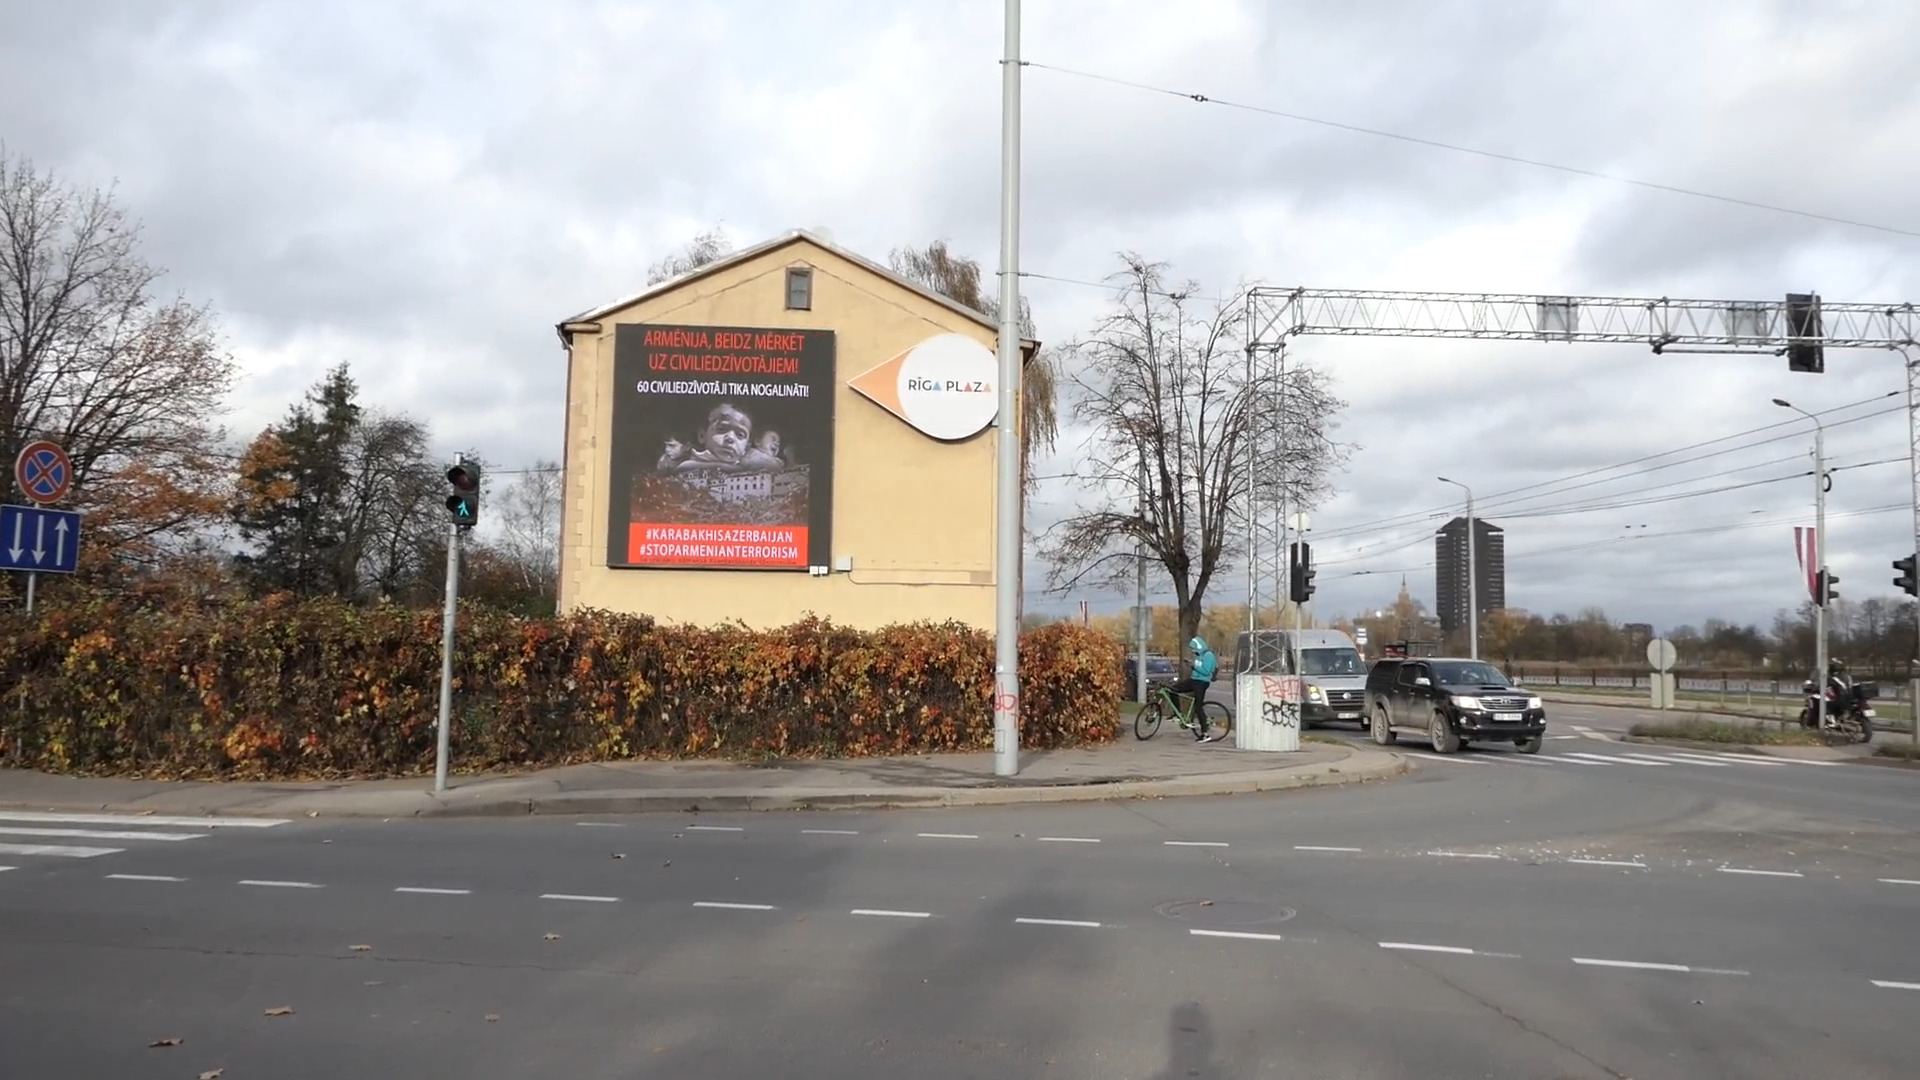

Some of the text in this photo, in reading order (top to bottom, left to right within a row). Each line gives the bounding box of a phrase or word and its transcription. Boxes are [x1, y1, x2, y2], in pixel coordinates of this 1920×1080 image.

[644, 329, 712, 349] ARMĒNIJA,
[715, 332, 752, 350] BEIDZ
[649, 354, 799, 374] UZ CIVILIEDZĪVOTĀJIEM!
[637, 380, 809, 397] 60 CIVILIEDZĪVOTĀJI TIKA NOGALINĀTI!
[946, 380, 992, 393] PLAZA
[645, 528, 793, 542] #KARABAKHISAZERBAIJAN
[640, 544, 798, 559] #STOPARMENIANTERRORISM
